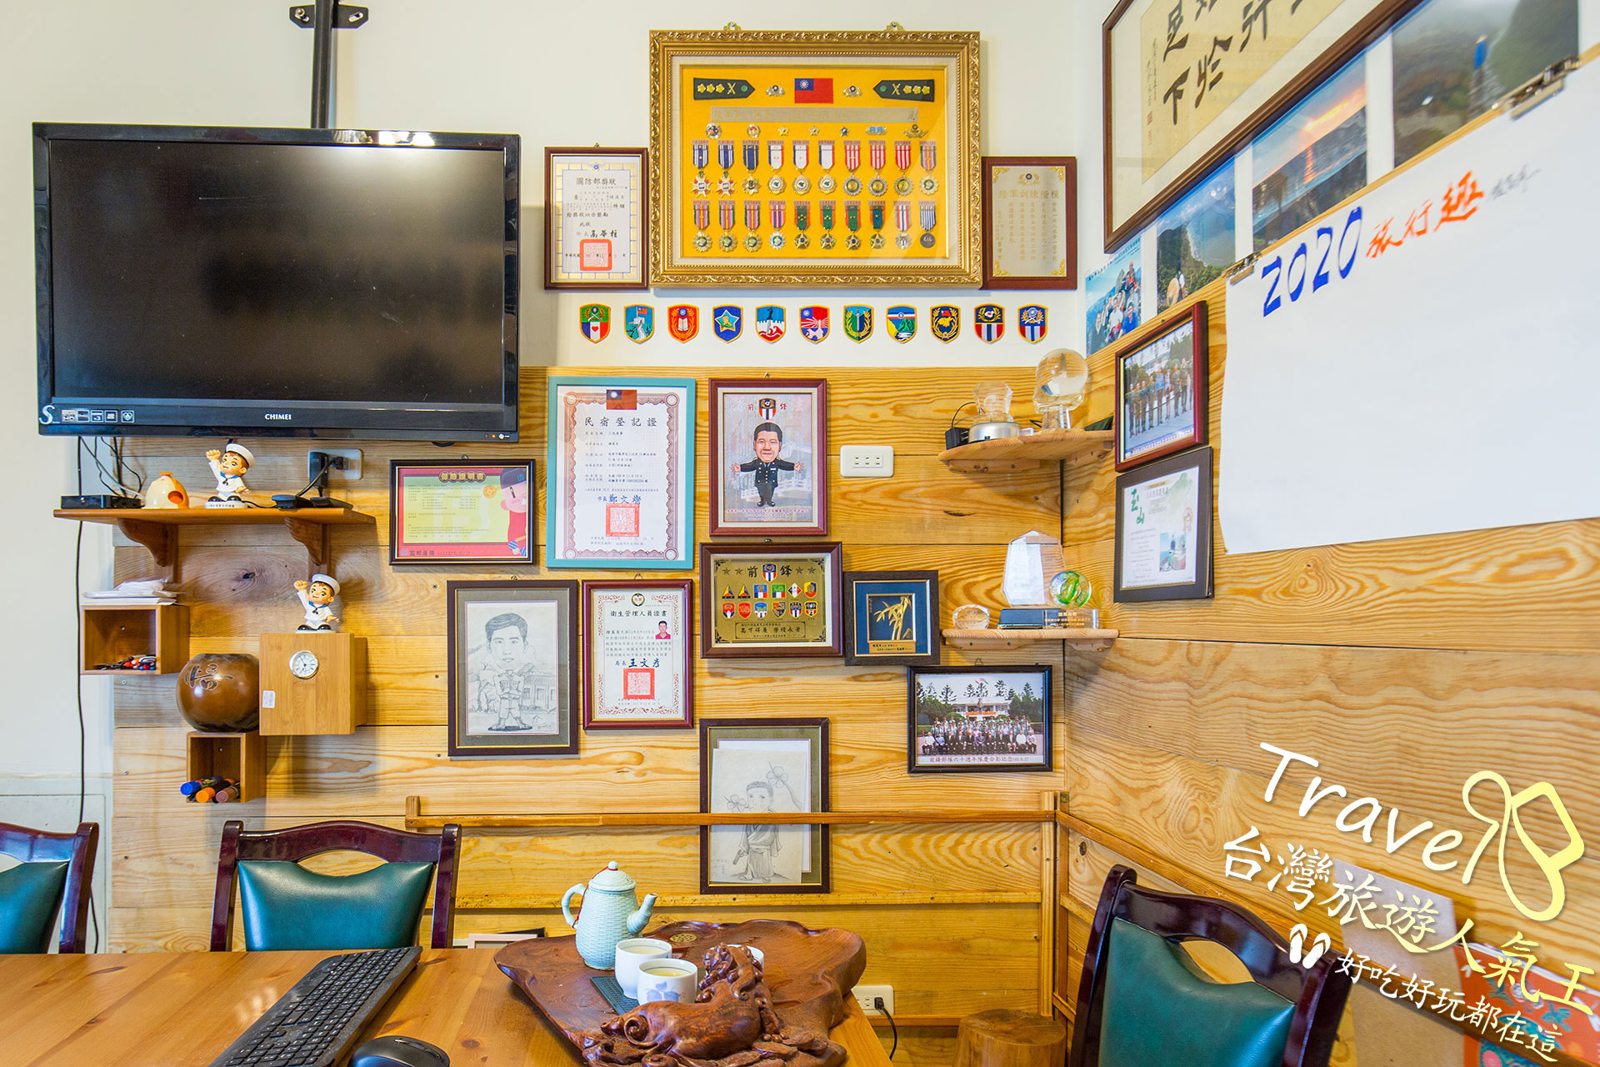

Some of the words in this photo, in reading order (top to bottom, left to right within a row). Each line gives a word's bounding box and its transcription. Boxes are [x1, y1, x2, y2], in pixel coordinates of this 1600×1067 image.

[1261, 206, 1363, 318] 2020
[1365, 170, 1485, 259] 旅行趣
[584, 416, 658, 427] 民宿登記證
[610, 610, 668, 618] 衛生管理人員證書
